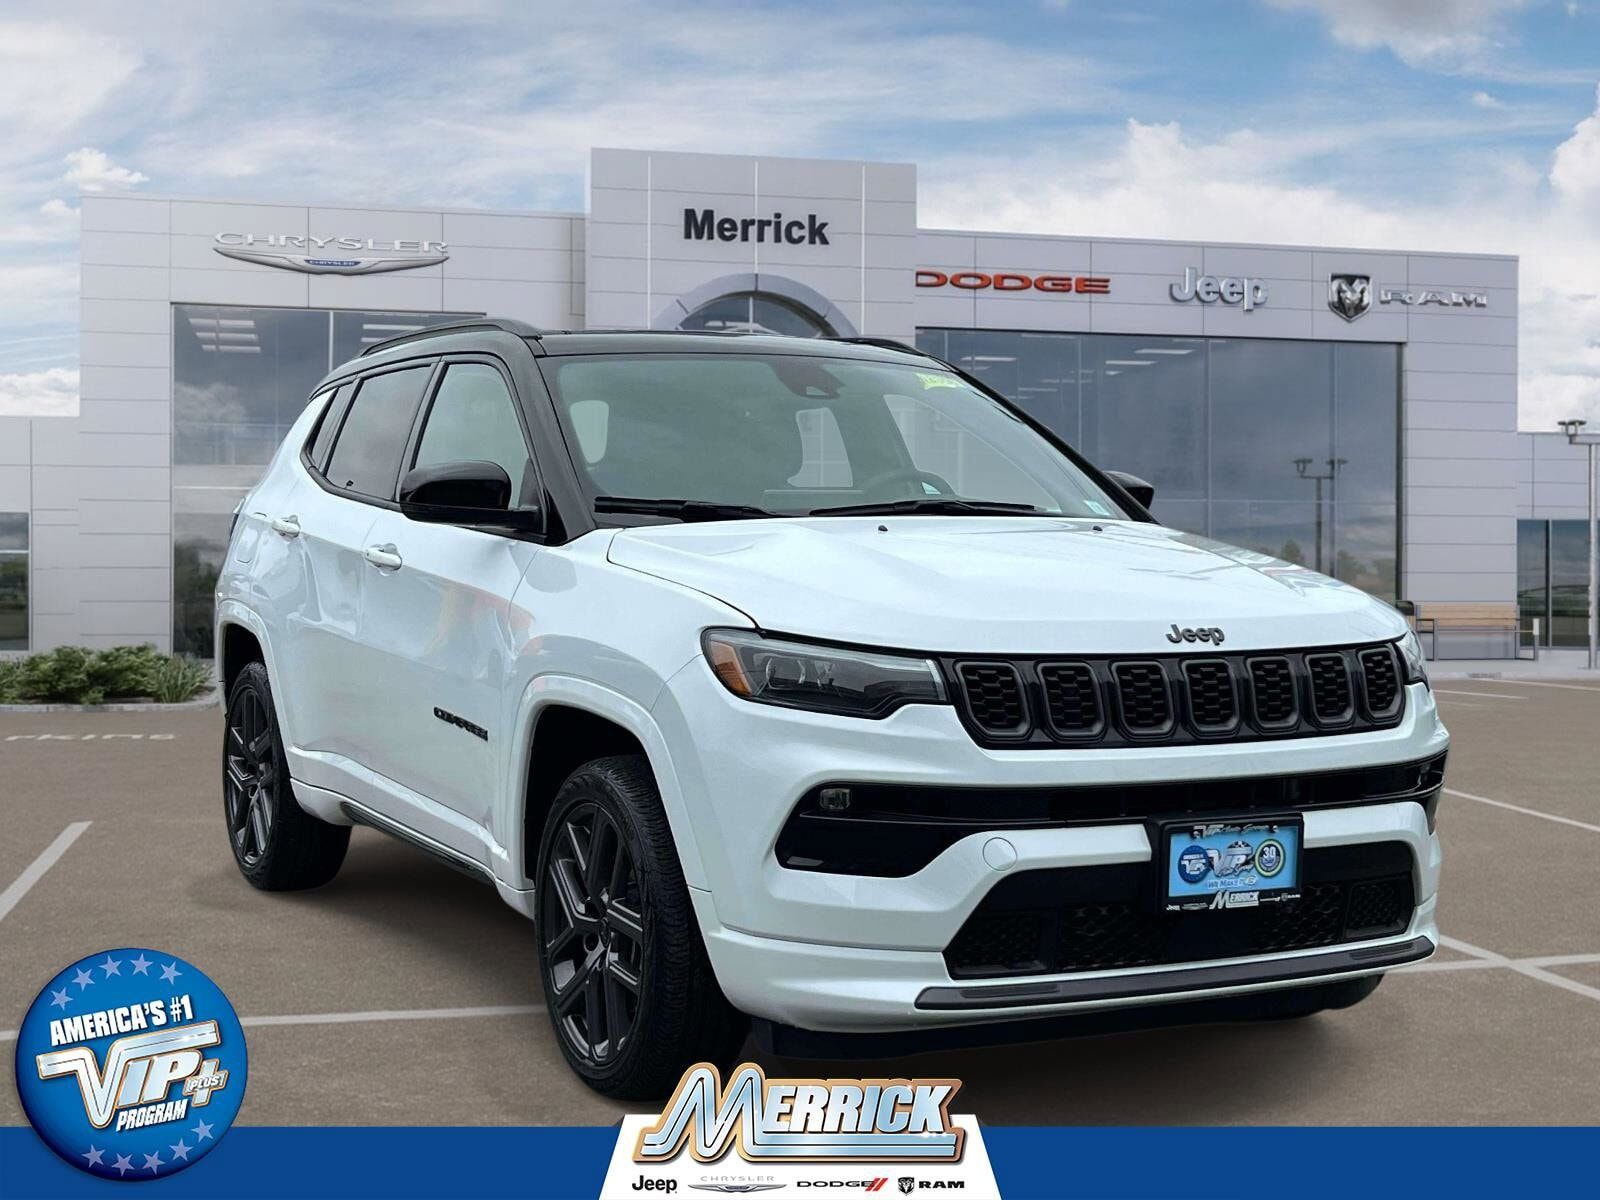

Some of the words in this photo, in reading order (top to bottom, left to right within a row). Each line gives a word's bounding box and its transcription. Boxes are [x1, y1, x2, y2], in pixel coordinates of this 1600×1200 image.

[683, 208, 830, 246] Merrick
[214, 231, 449, 253] CHRYSLER
[915, 270, 1111, 295] DODGE
[1169, 266, 1268, 312] Jeep
[1380, 289, 1488, 308] RAM
[1165, 623, 1225, 646] Jeep
